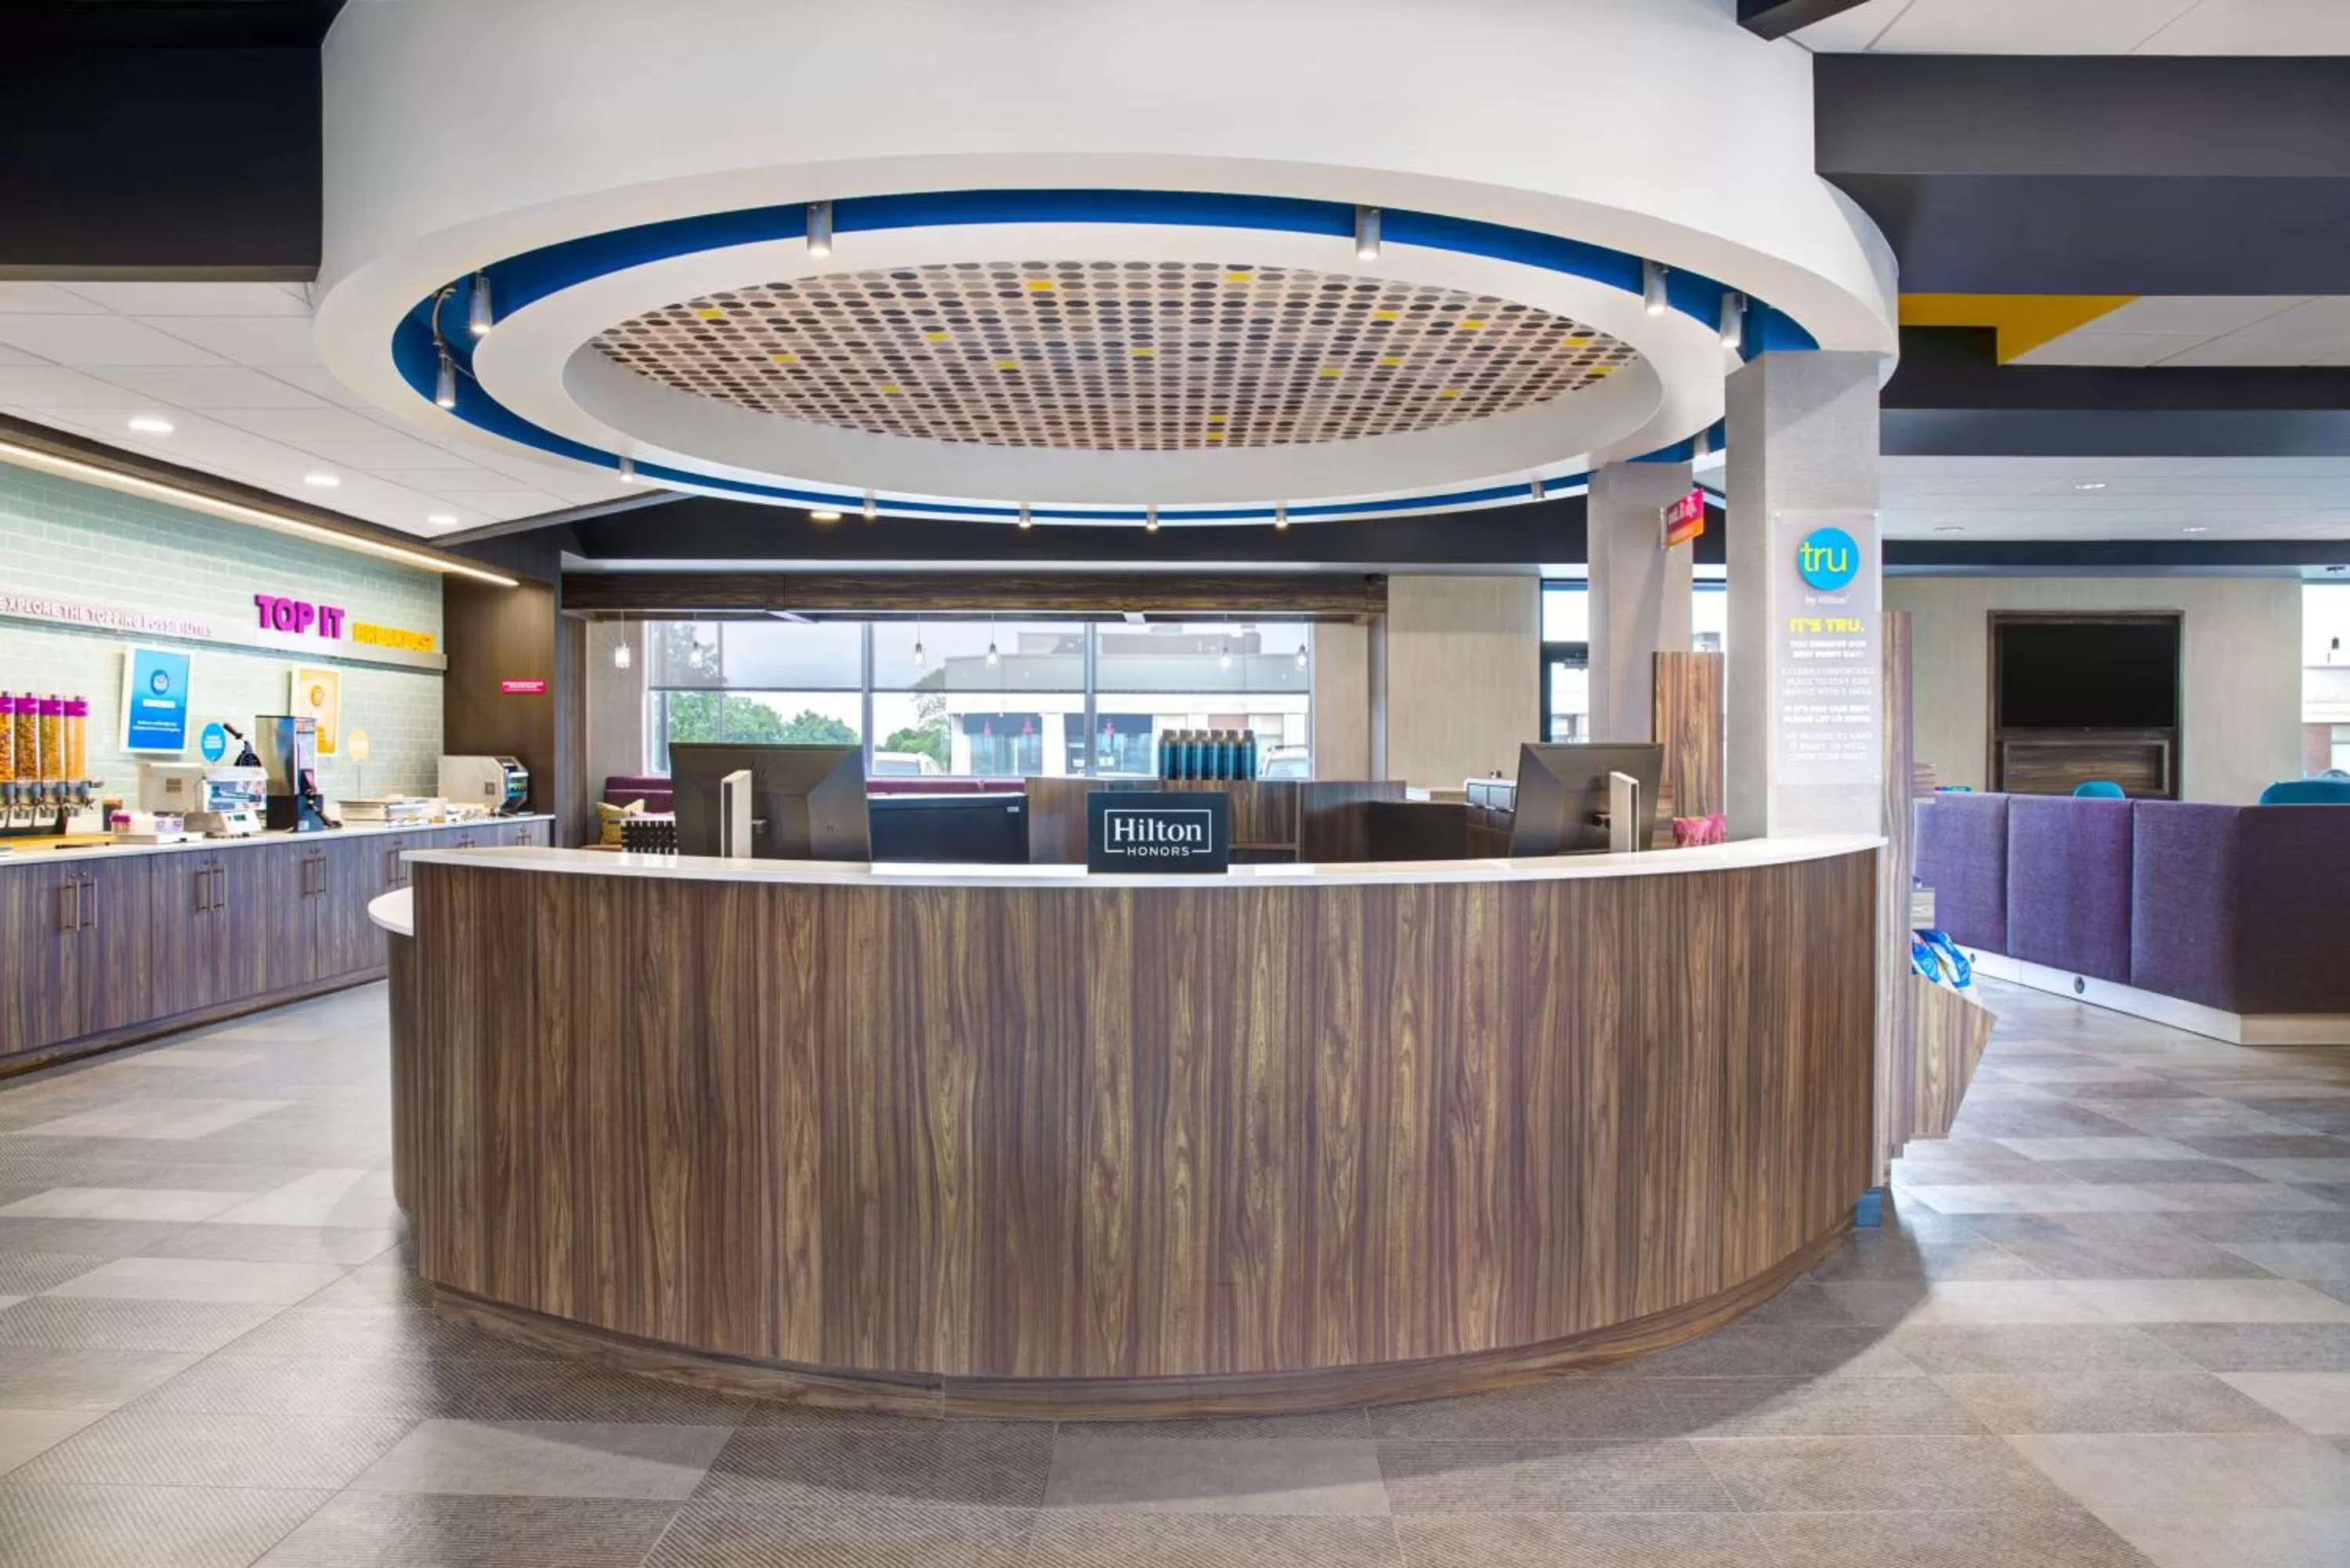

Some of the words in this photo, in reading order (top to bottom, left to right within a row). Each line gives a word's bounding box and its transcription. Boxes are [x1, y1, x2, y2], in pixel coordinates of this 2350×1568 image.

[1799, 540, 1847, 573] tru
[254, 594, 315, 634] TOP
[319, 605, 345, 639] IT
[1113, 817, 1202, 842] Hilton
[1126, 847, 1191, 857] HONORS
